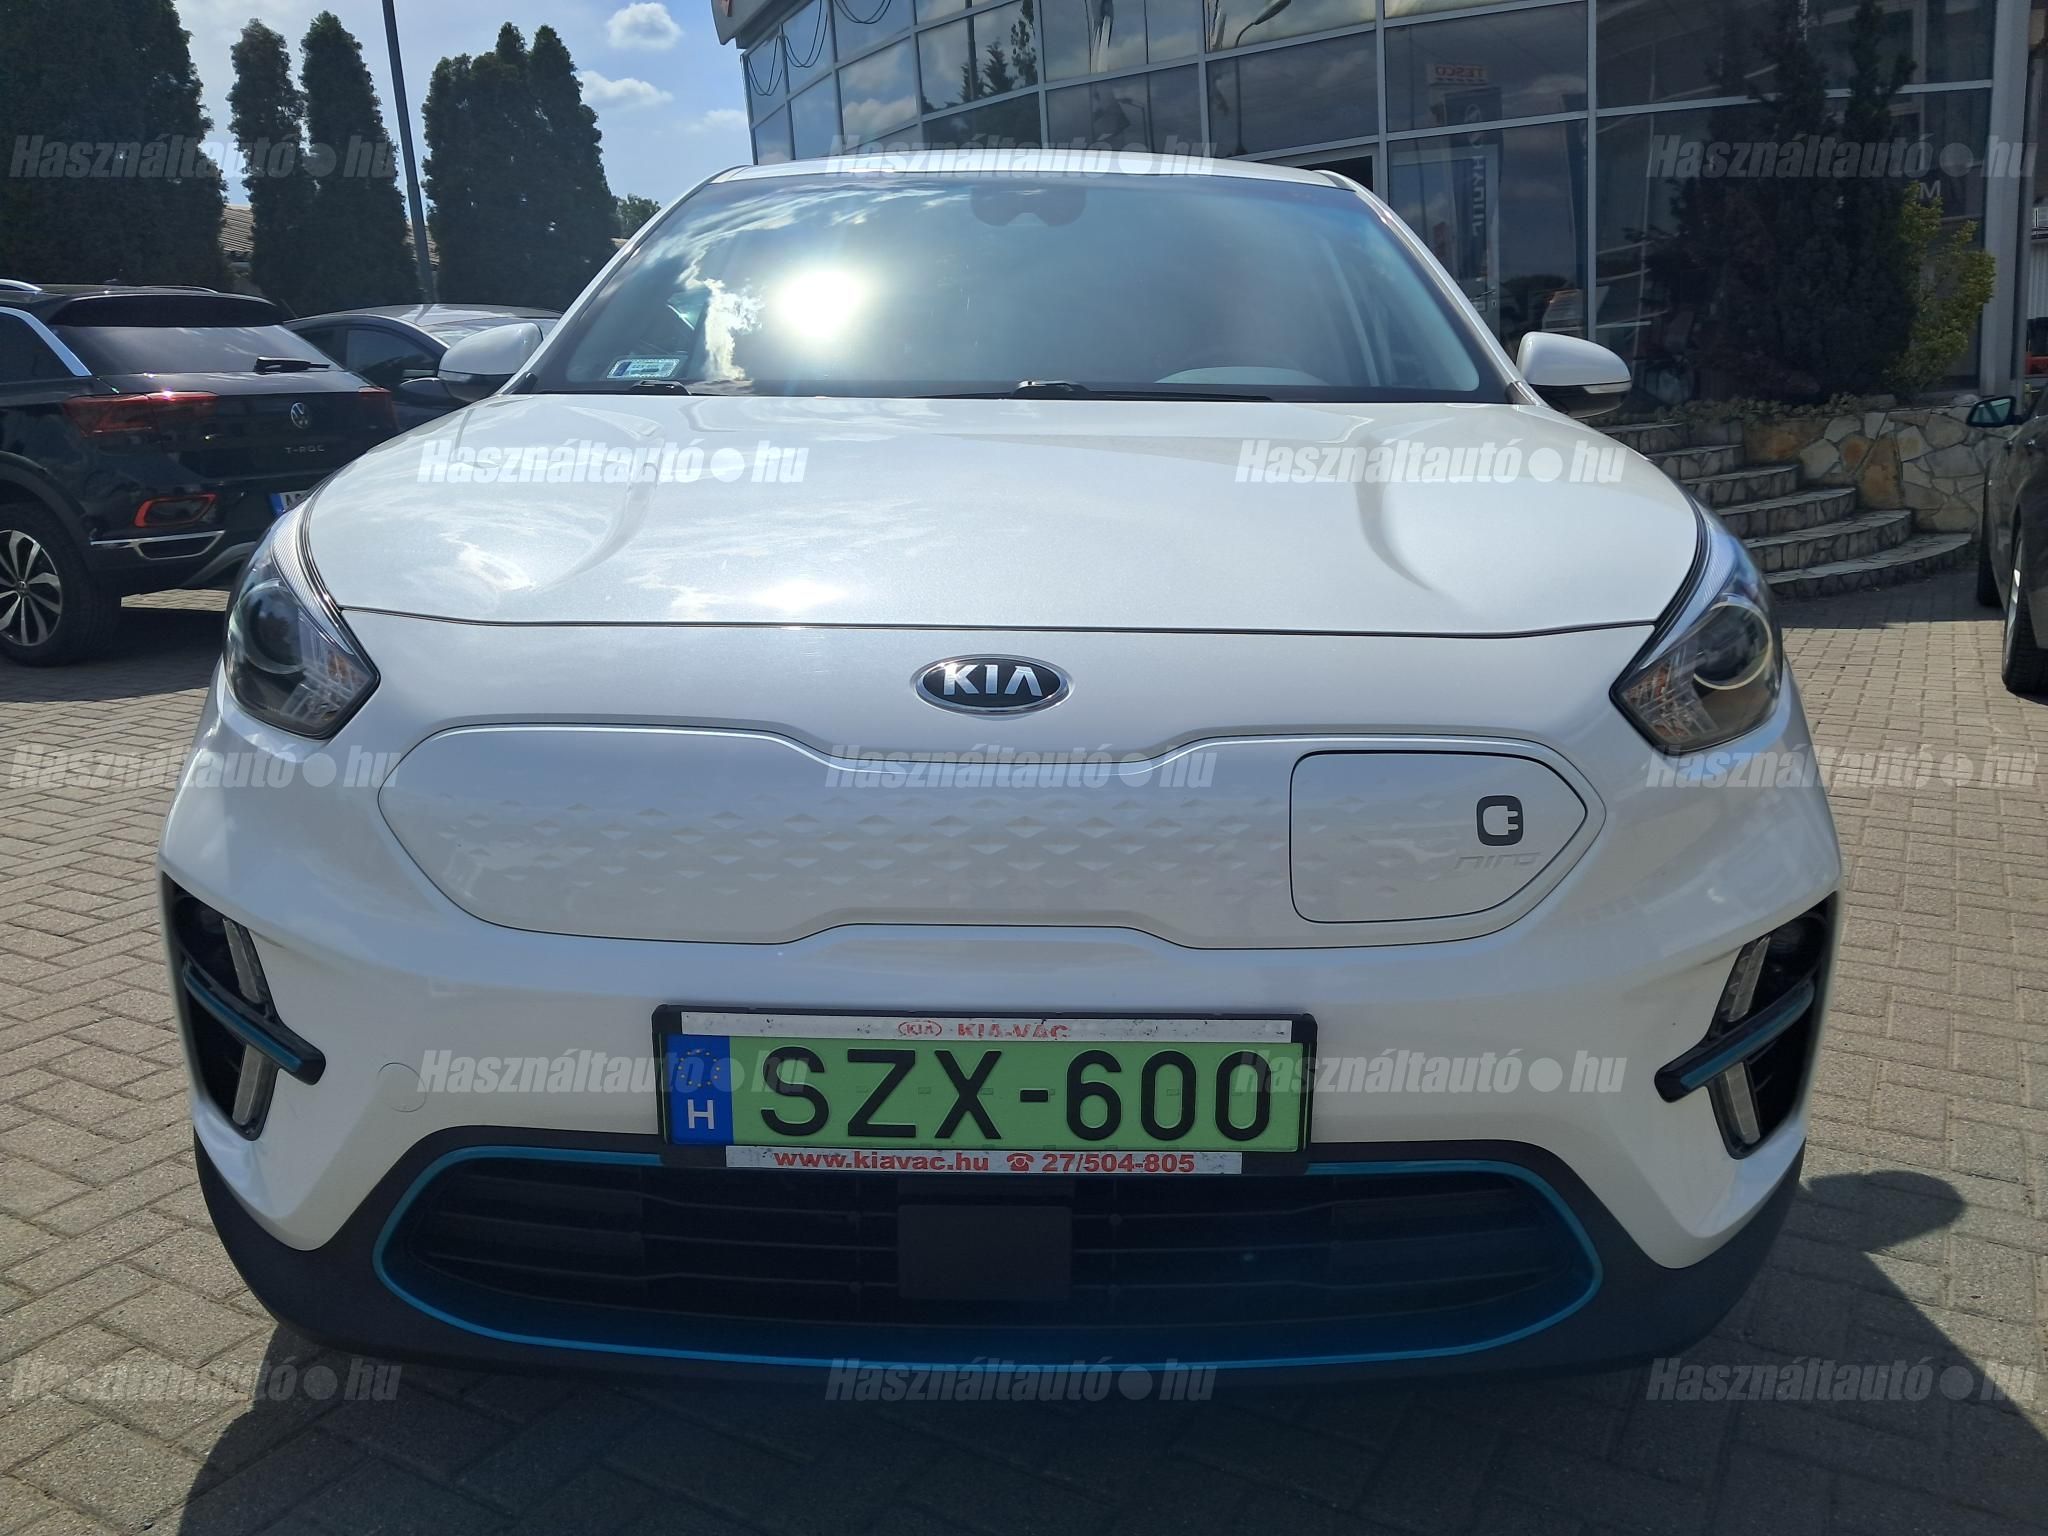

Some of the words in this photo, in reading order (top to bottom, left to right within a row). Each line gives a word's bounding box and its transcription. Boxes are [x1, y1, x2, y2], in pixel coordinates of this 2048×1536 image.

[943, 663, 1043, 697] KIA
[760, 1045, 1272, 1141] SZX-600
[687, 1099, 715, 1130] H
[774, 1151, 990, 1172] www.kiavac.hu
[1043, 1153, 1196, 1173] 27/504-805
